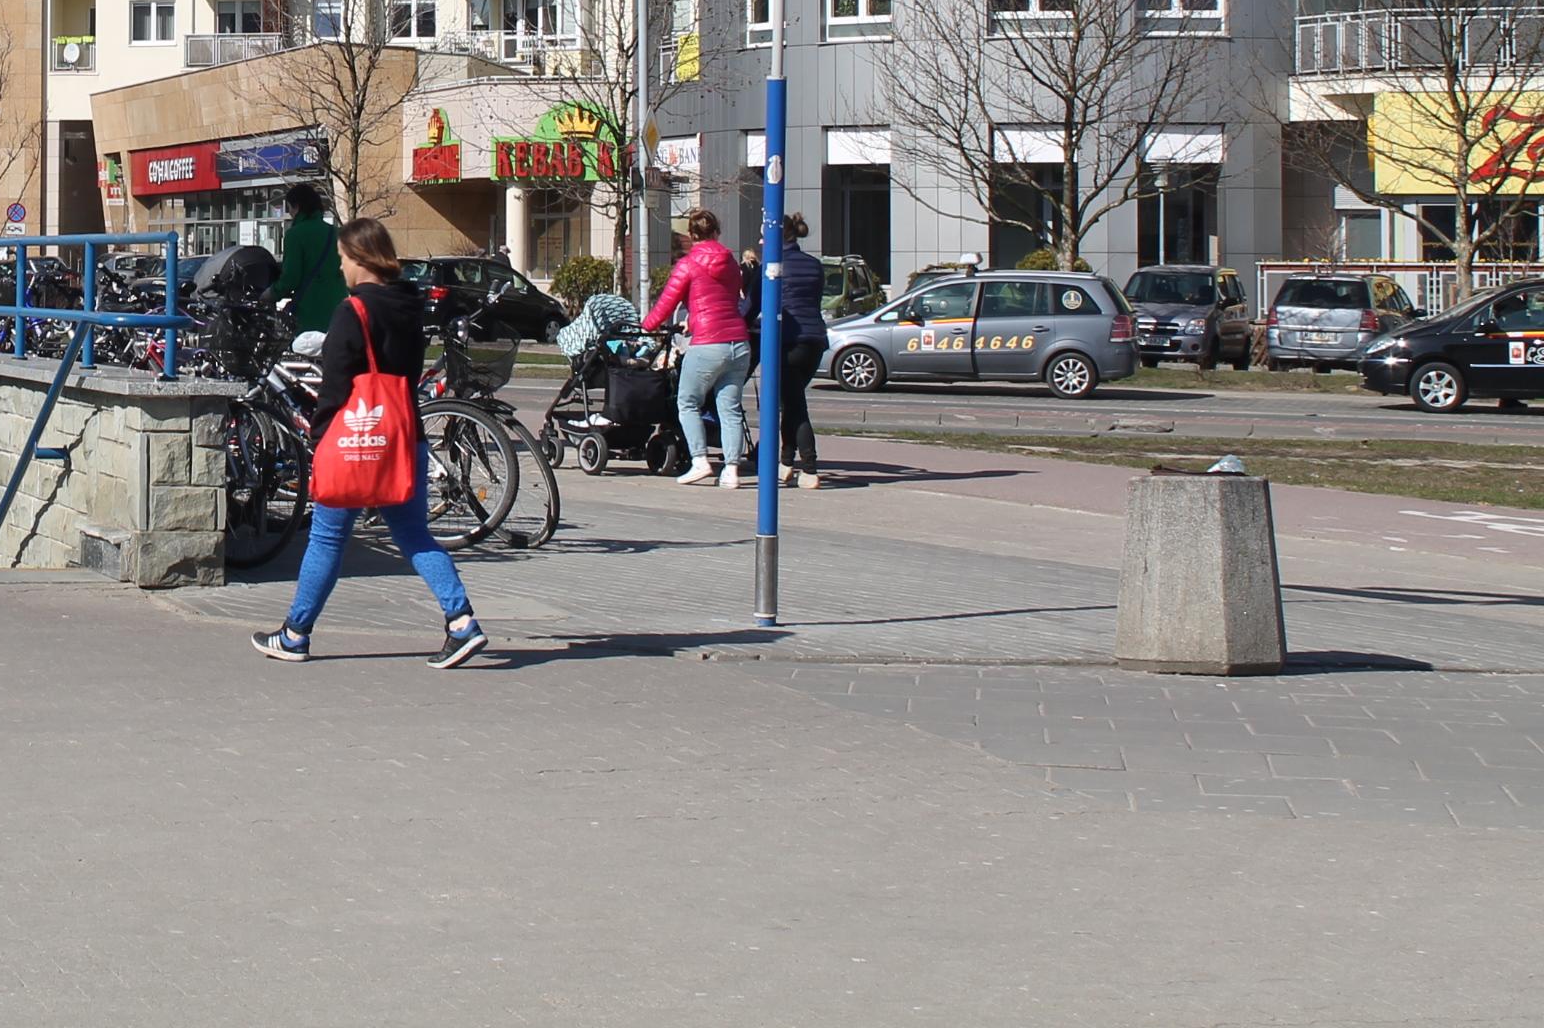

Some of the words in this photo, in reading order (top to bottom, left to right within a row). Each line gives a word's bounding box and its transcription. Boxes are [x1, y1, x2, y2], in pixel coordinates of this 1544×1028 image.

[169, 157, 194, 181] COFFEE
[496, 141, 585, 178] KEBAB
[337, 433, 387, 448] adidas
[343, 453, 382, 462] ORIGNALS
